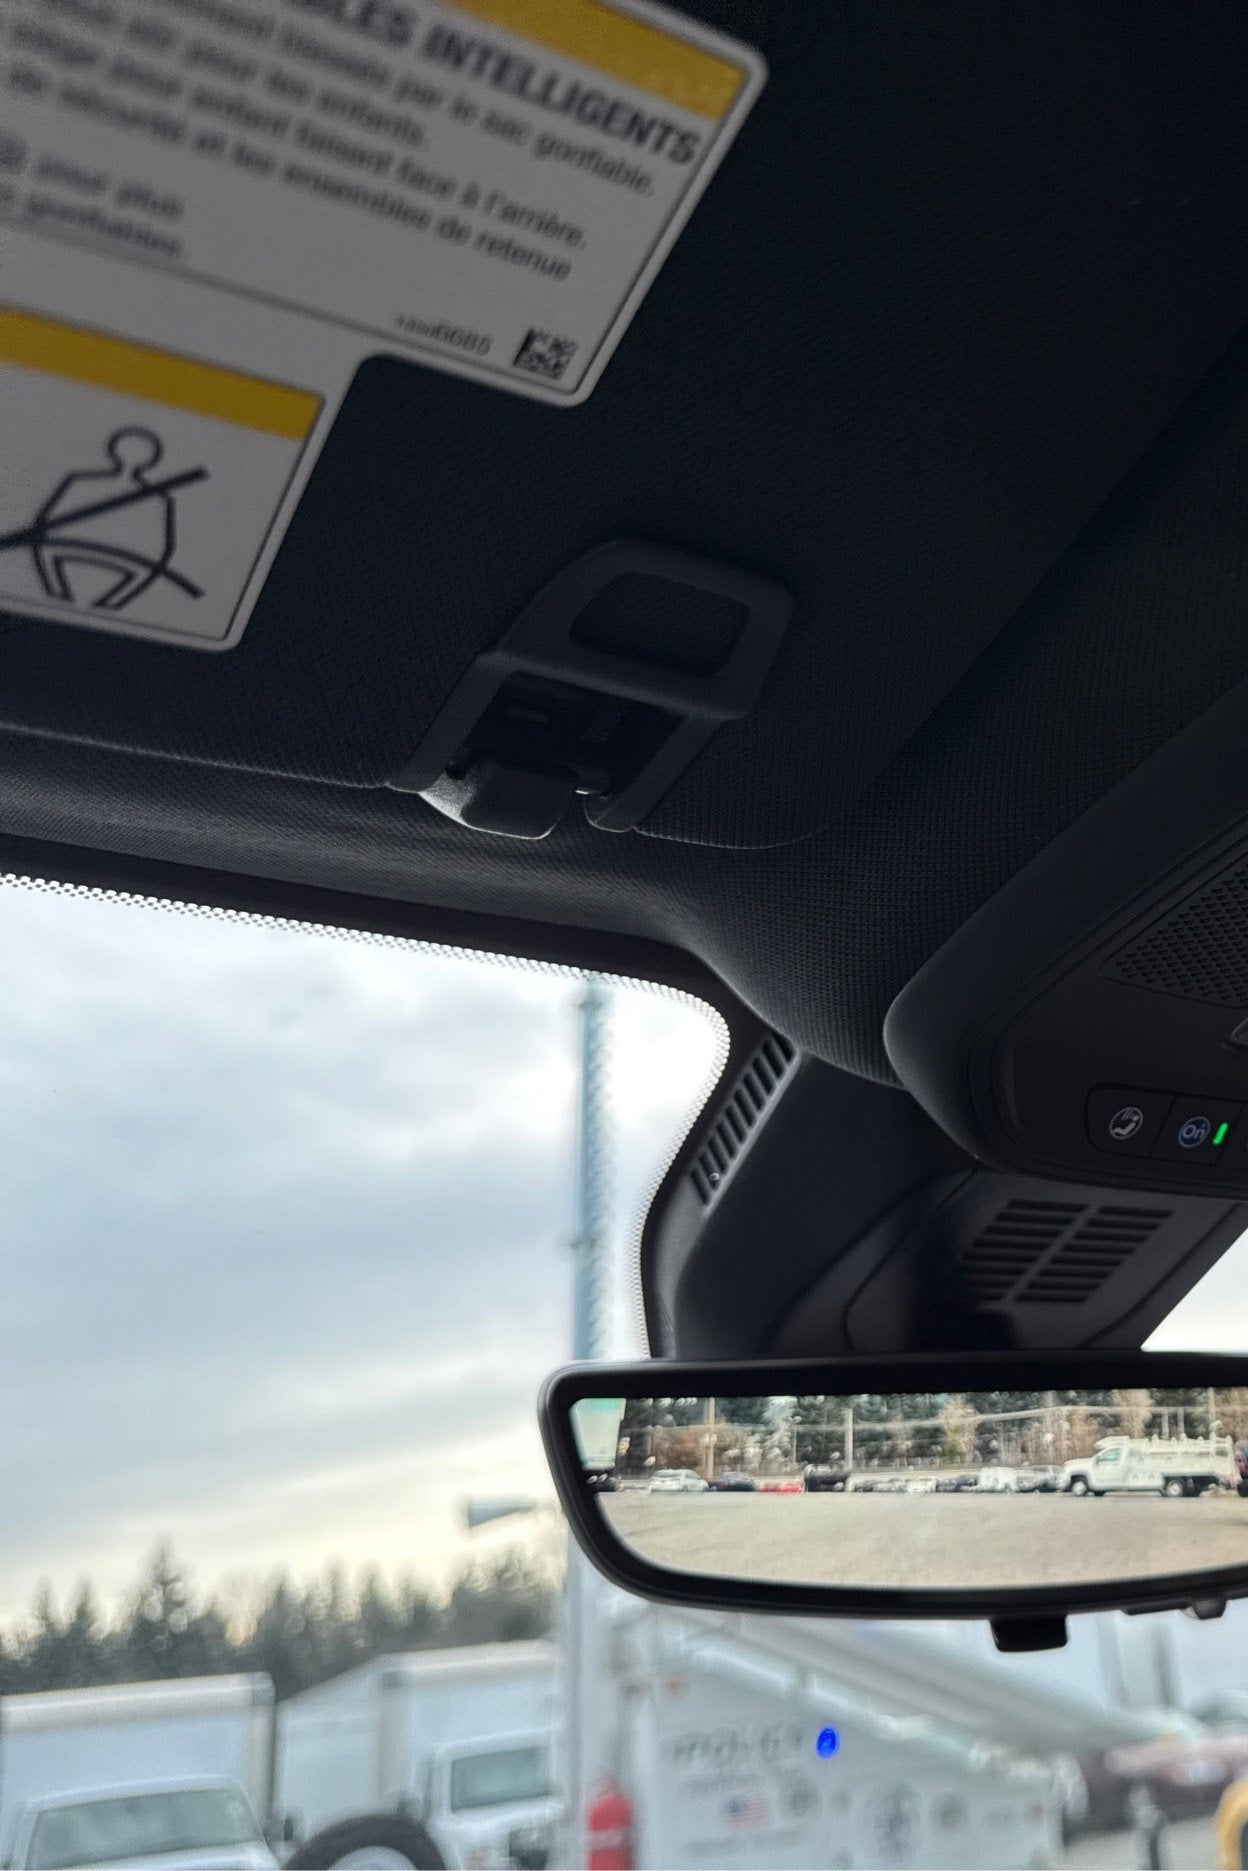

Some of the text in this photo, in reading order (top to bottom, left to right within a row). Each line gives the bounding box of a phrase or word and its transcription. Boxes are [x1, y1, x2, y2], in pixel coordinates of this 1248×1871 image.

[420, 22, 700, 168] INTELLIGENTS
[188, 84, 293, 140] enfant
[396, 152, 458, 202] face
[460, 178, 483, 210] à
[481, 186, 588, 250] l'arrière.
[279, 158, 434, 234] ensembles
[434, 212, 474, 246] de
[473, 228, 573, 283] retenue
[531, 129, 655, 197] gonflable.
